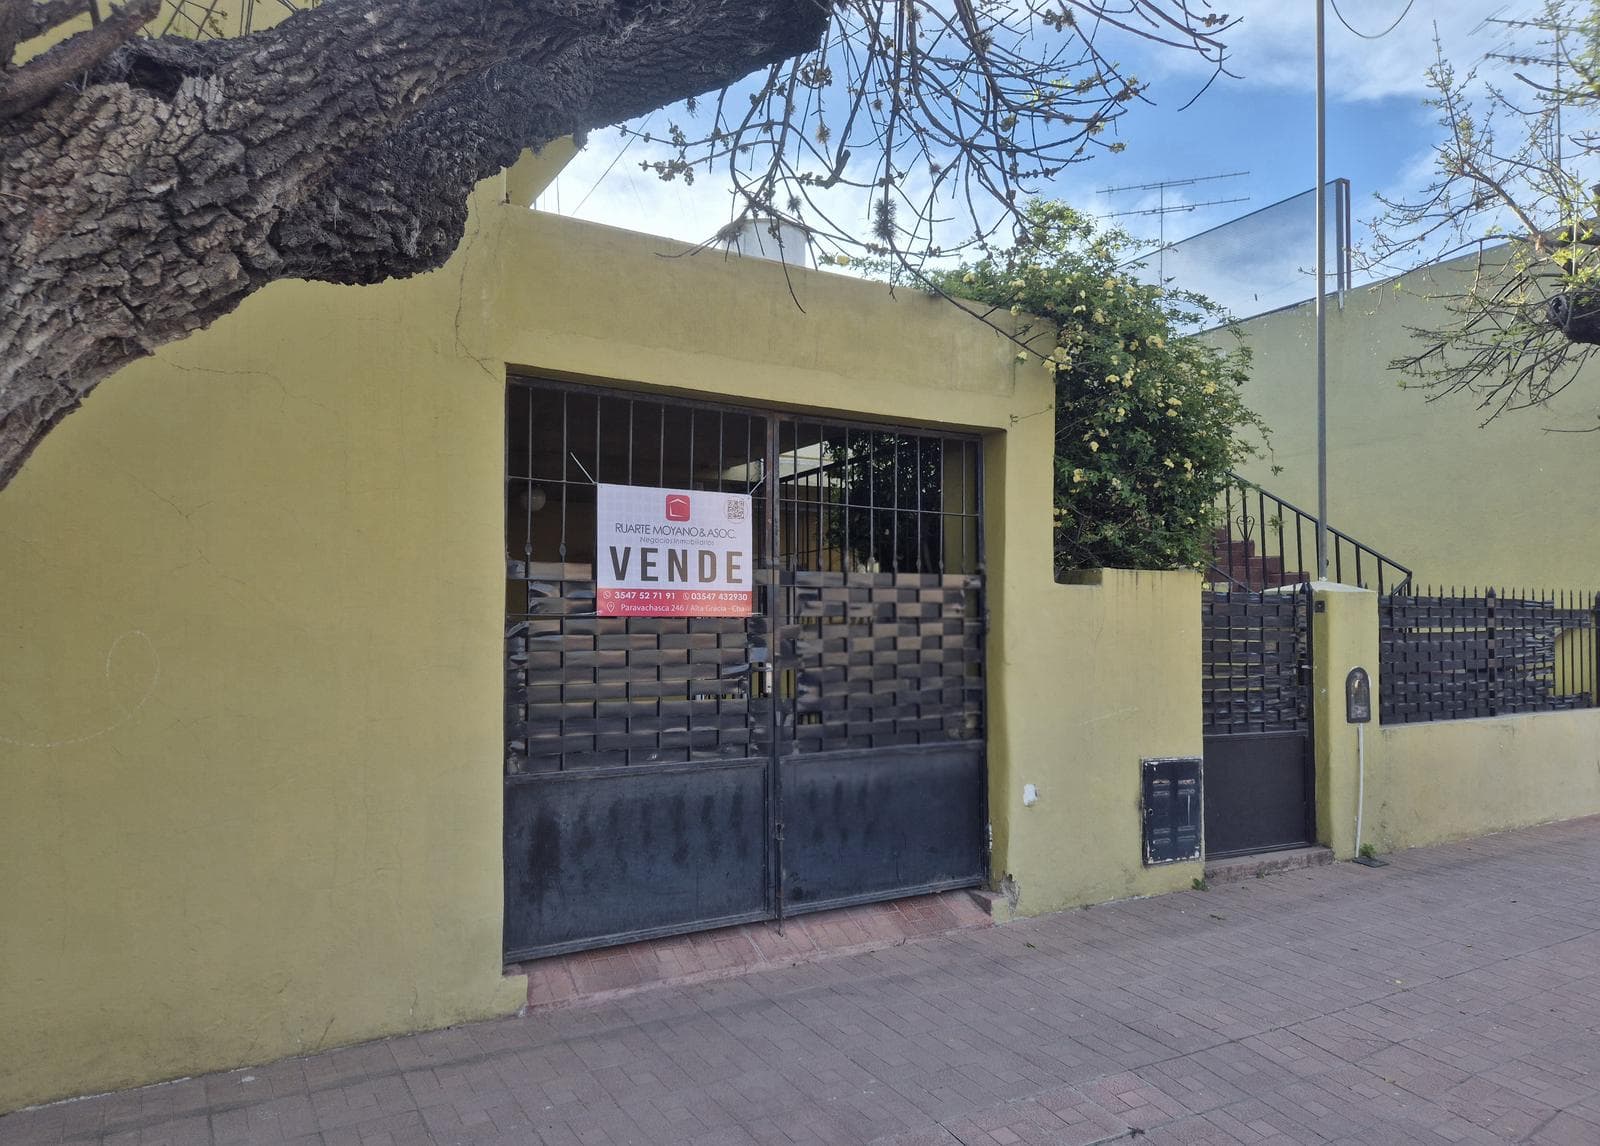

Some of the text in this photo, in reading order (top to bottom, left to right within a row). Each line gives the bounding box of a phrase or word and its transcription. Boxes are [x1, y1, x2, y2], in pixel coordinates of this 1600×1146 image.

[615, 523, 651, 535] RUARTE
[653, 525, 698, 538] MOYANO
[609, 546, 743, 584] VENDE
[614, 592, 636, 600] 3547
[639, 592, 650, 600] 52
[653, 592, 663, 600] 71
[666, 592, 675, 600] 91
[691, 593, 716, 601] 03547
[621, 604, 669, 613] Paravachasca
[671, 604, 684, 612] 246
